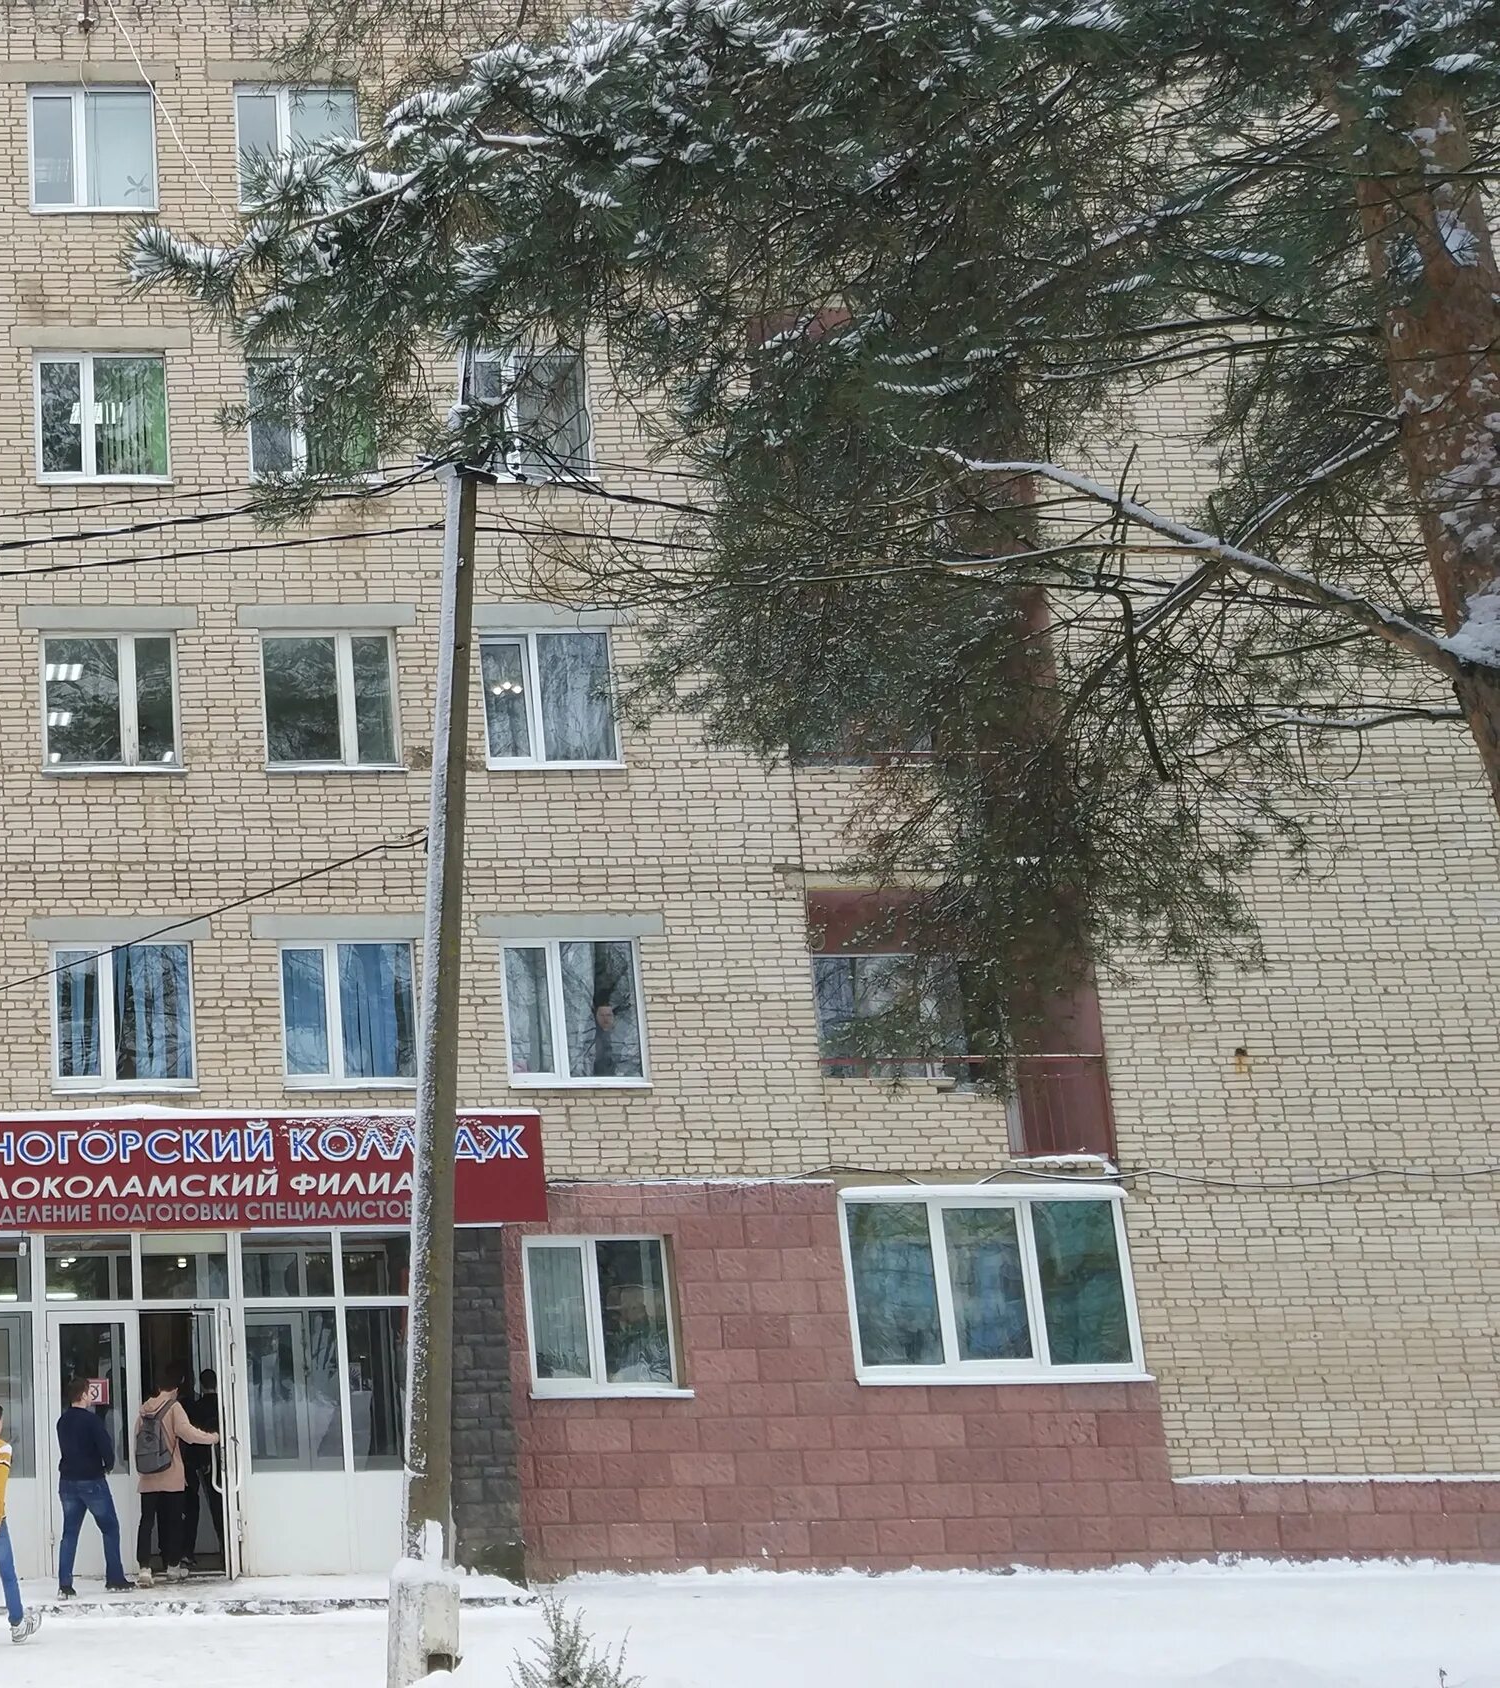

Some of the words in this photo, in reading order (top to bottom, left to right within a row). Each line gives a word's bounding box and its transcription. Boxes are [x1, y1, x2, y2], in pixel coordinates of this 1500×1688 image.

[289, 1125, 529, 1163] КОЛЛДЖ
[289, 1171, 414, 1195] ФИЛИА
[98, 1202, 239, 1223] ПОДГОТОВКИ
[245, 1200, 412, 1221] СПЕЦИАЛИСТОВ
